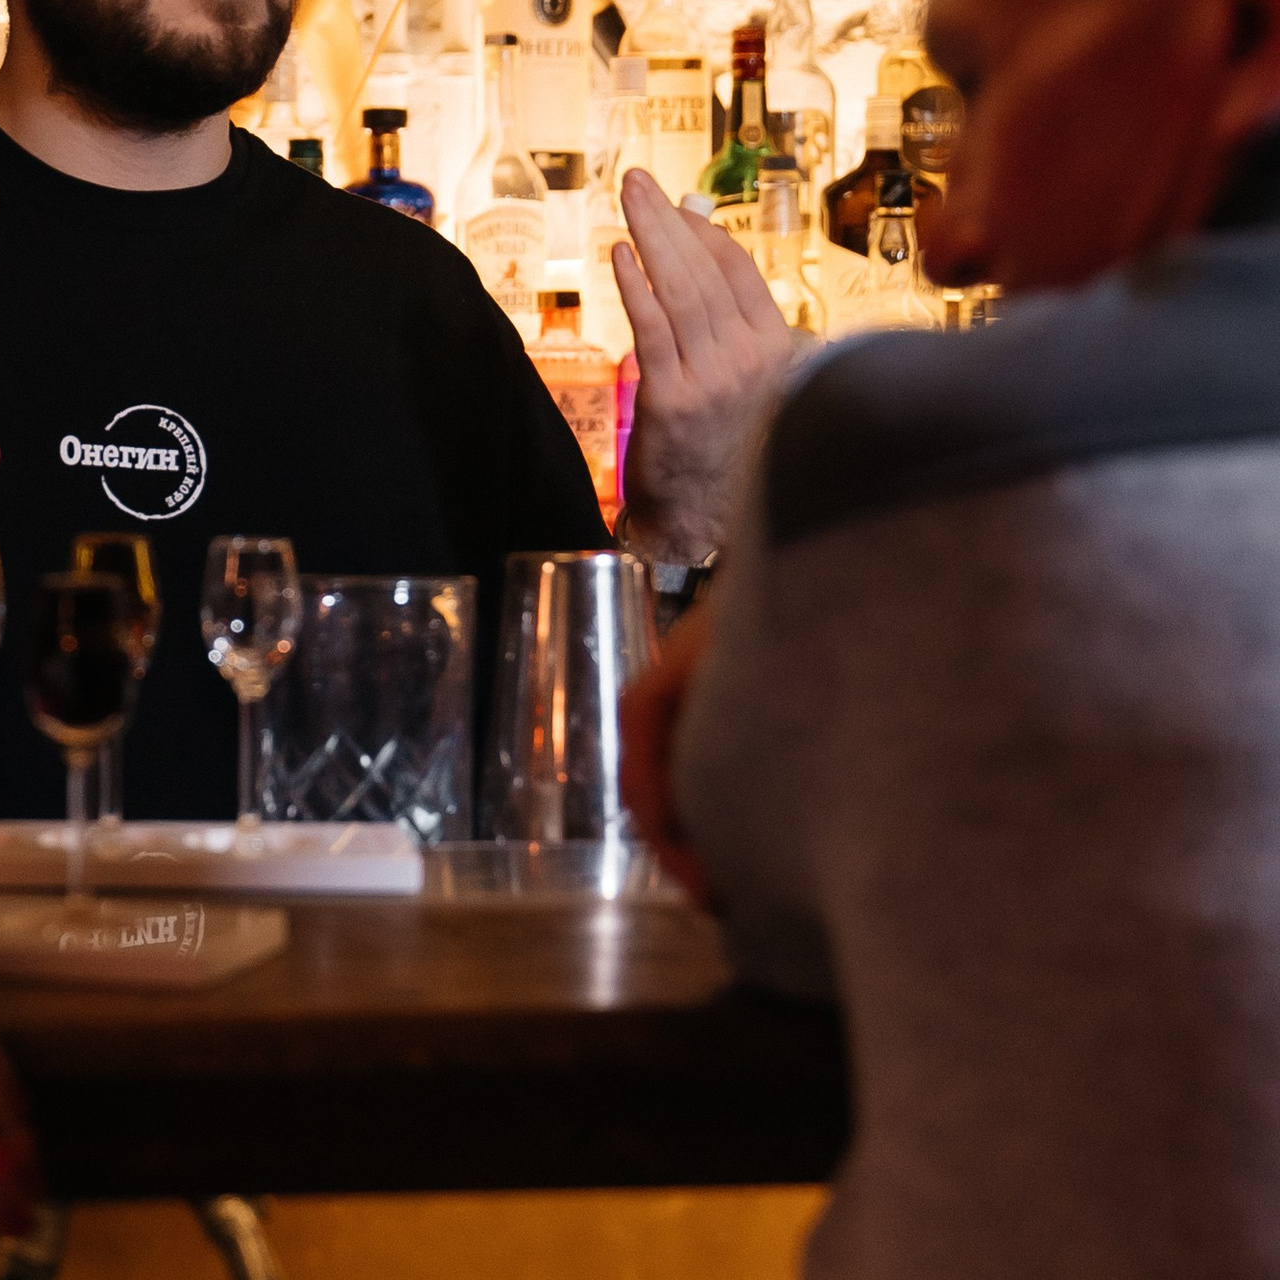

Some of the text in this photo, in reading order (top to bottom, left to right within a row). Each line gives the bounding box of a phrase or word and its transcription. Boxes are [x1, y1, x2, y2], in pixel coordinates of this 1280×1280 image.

[59, 435, 180, 471] Онегин
[158, 417, 199, 507] КРЕПКИЙ КОФЕ
